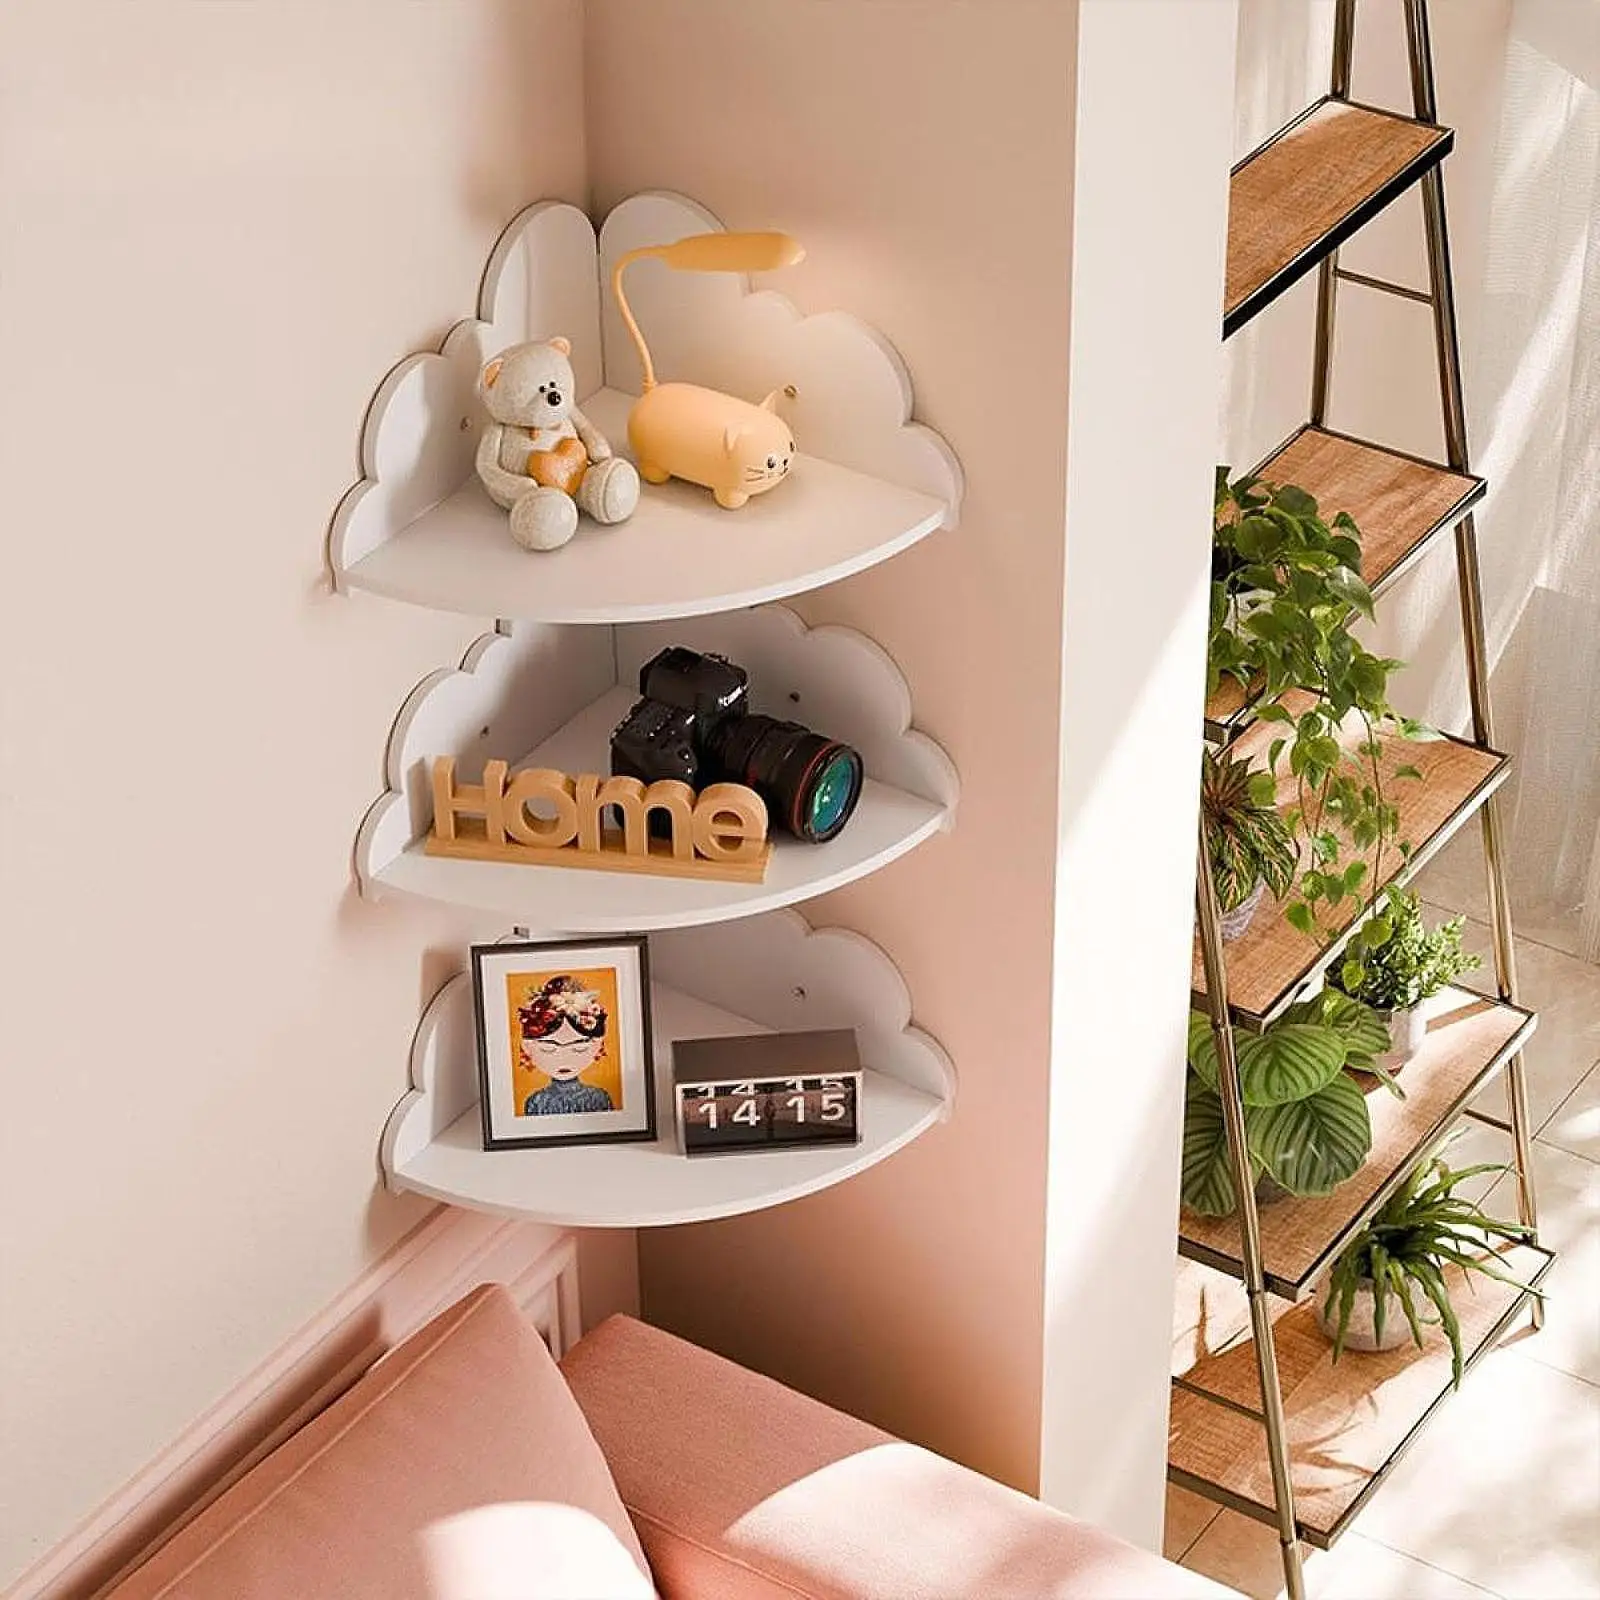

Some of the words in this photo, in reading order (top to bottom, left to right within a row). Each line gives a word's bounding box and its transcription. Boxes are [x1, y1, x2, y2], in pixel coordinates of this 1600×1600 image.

[434, 756, 767, 861] Home
[699, 1099, 760, 1129] 14
[786, 1094, 846, 1123] 15
